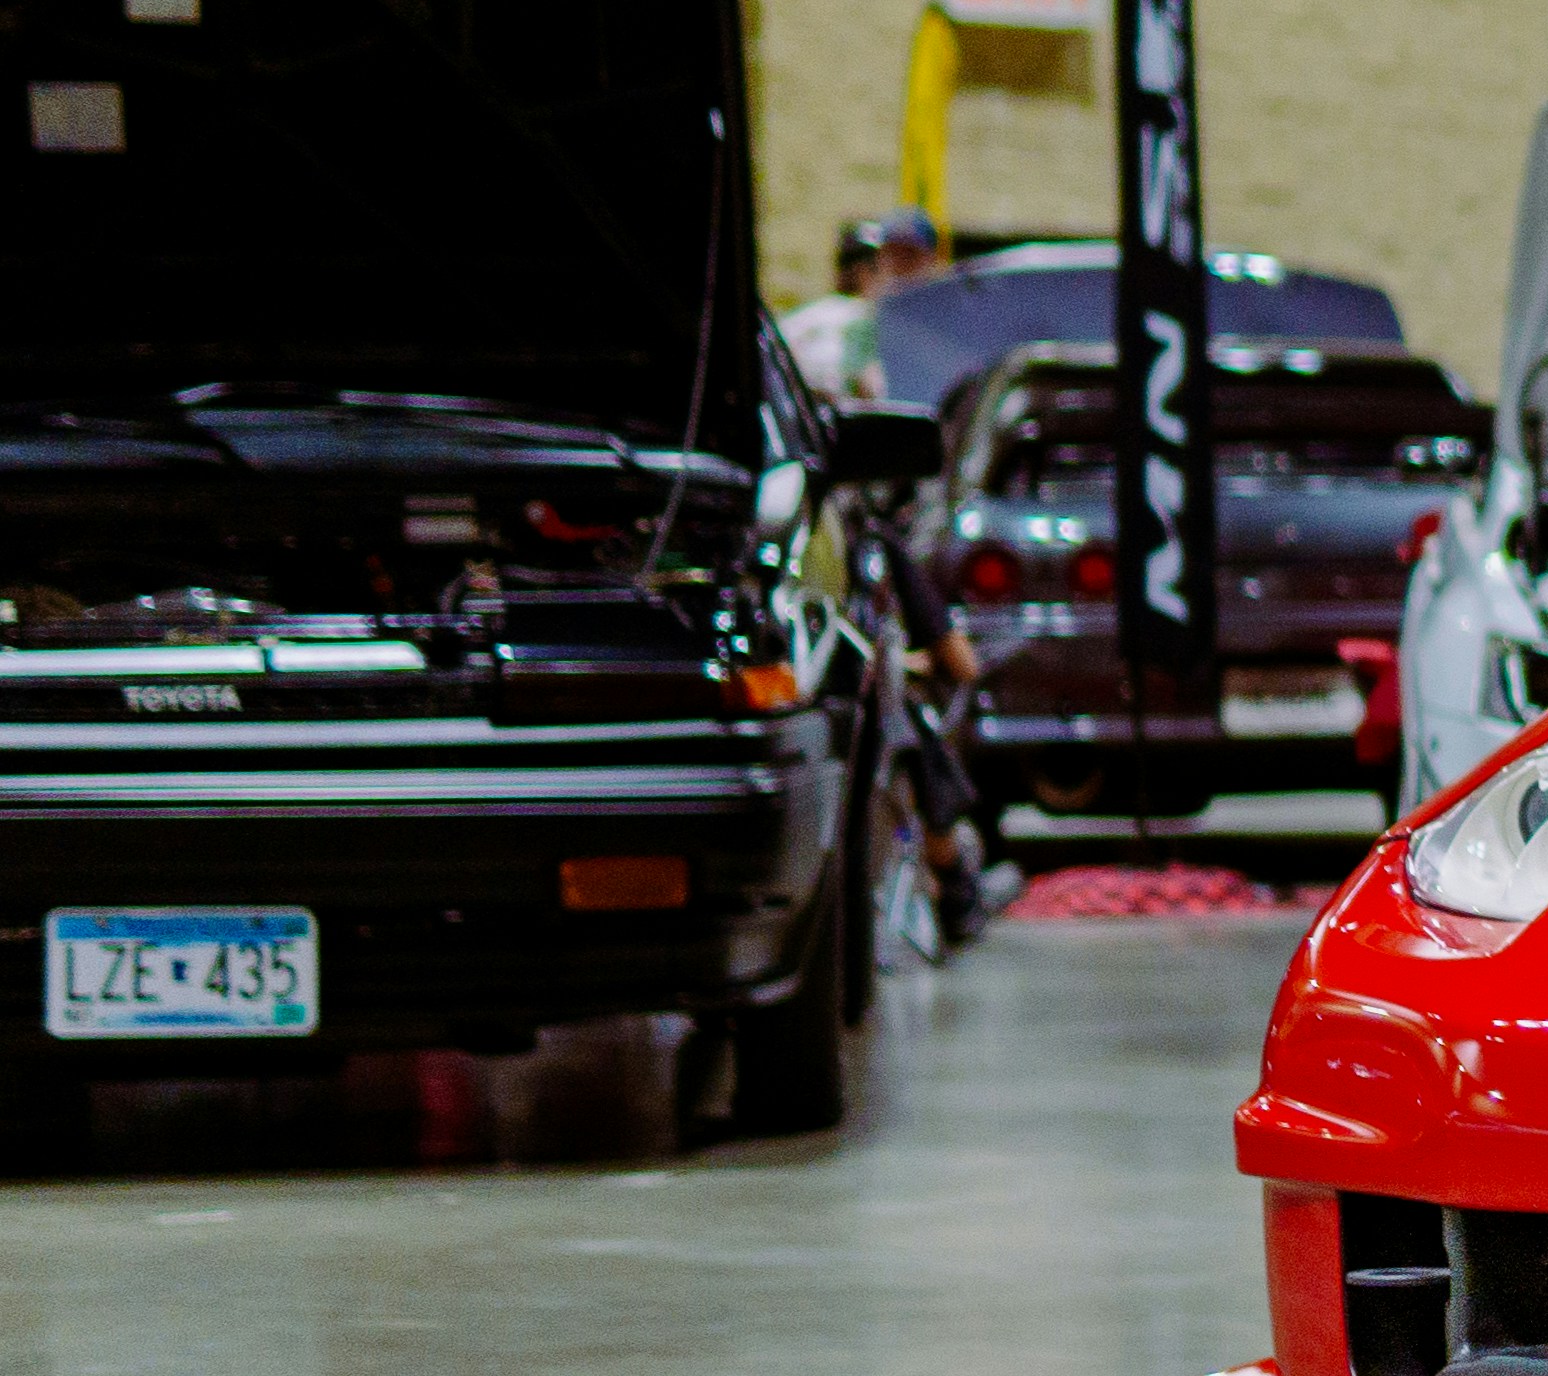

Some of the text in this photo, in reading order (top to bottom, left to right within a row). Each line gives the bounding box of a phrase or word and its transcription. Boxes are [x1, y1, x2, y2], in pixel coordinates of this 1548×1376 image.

[122, 685, 243, 712] TOYOTA
[65, 940, 298, 1003] LZE 435
